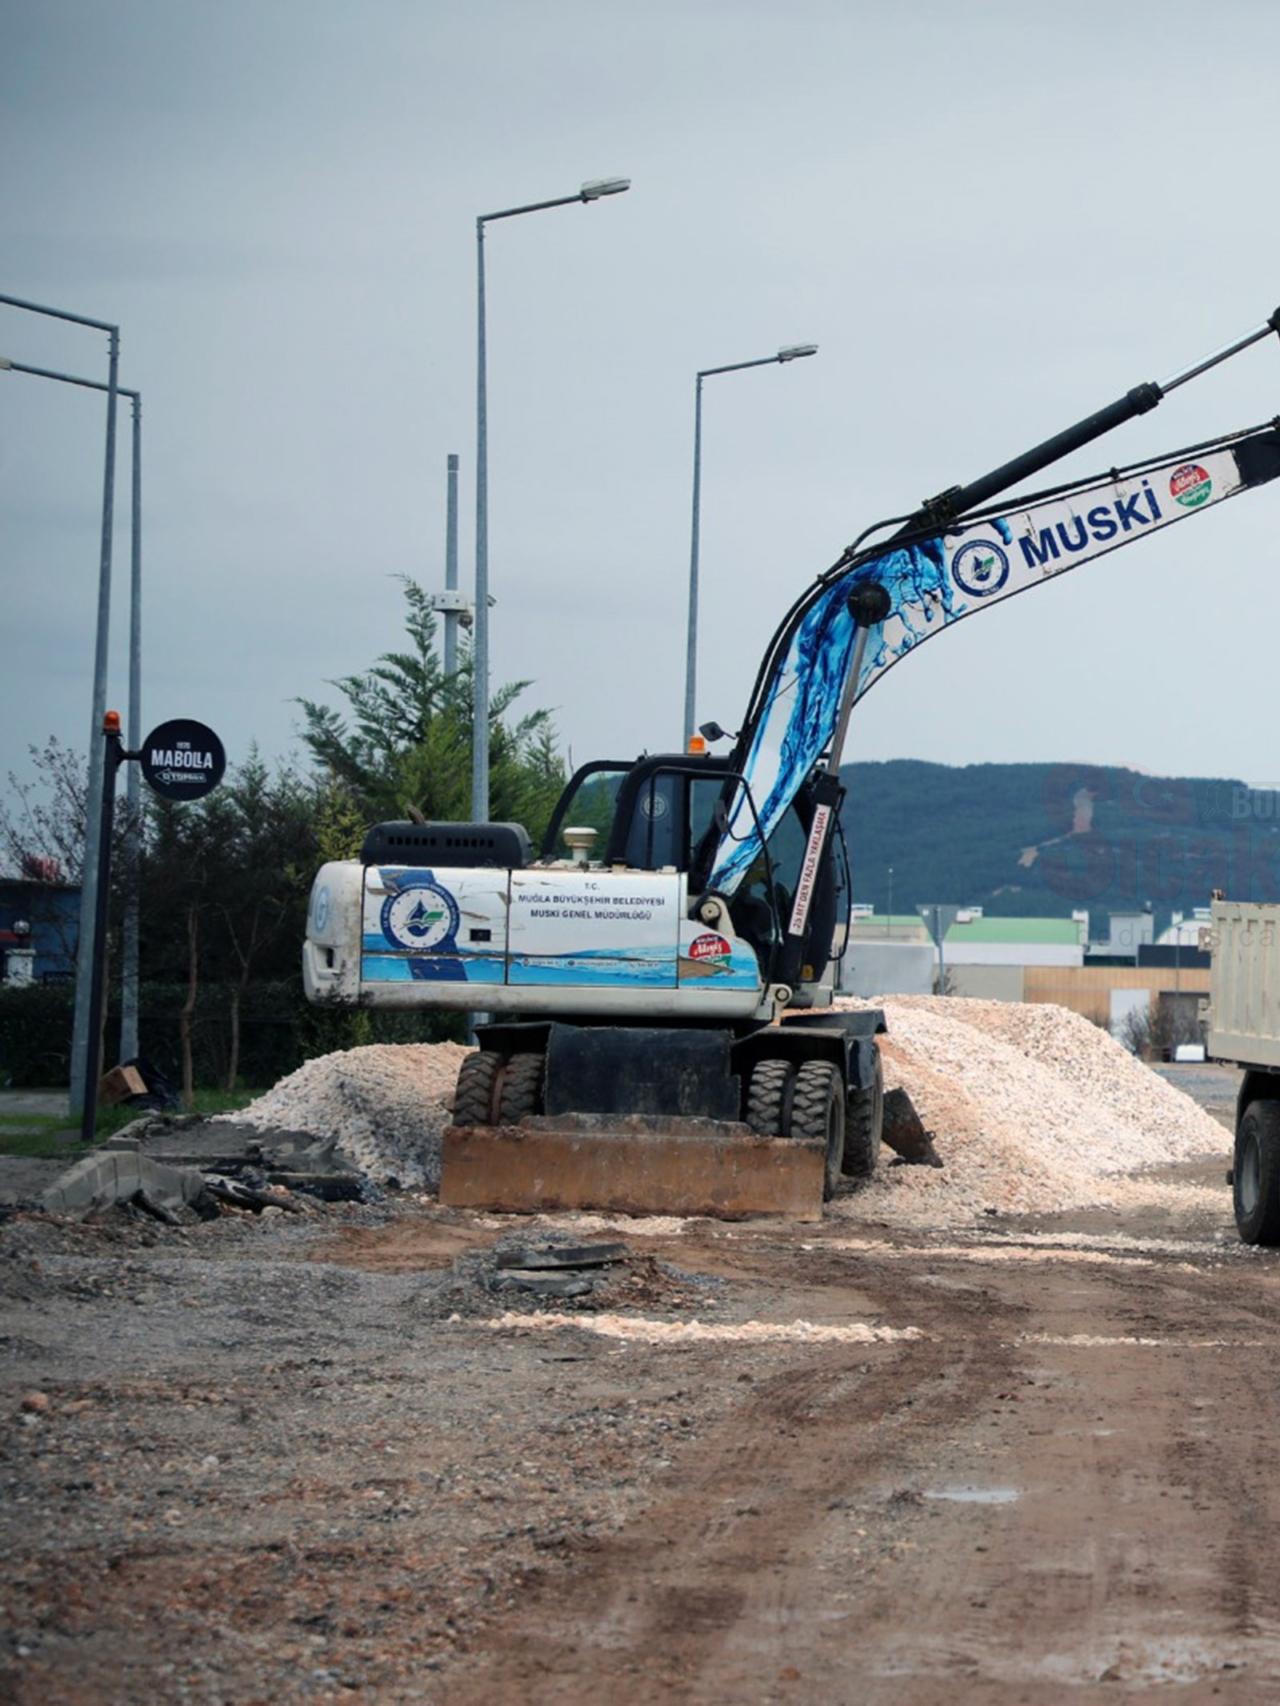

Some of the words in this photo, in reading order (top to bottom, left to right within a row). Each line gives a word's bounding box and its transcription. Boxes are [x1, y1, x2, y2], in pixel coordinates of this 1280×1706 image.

[1017, 479, 1163, 569] MUSKİ
[151, 749, 213, 769] MABOLLA
[518, 894, 550, 903] MUĞLA
[553, 895, 611, 906] BÜYÜKŞEHİR
[613, 896, 665, 906] BELEDİYESİ
[530, 908, 560, 918] MUSKİ
[562, 909, 592, 919] GENEL
[595, 910, 651, 921] MÜDÜRLÜĞÜ
